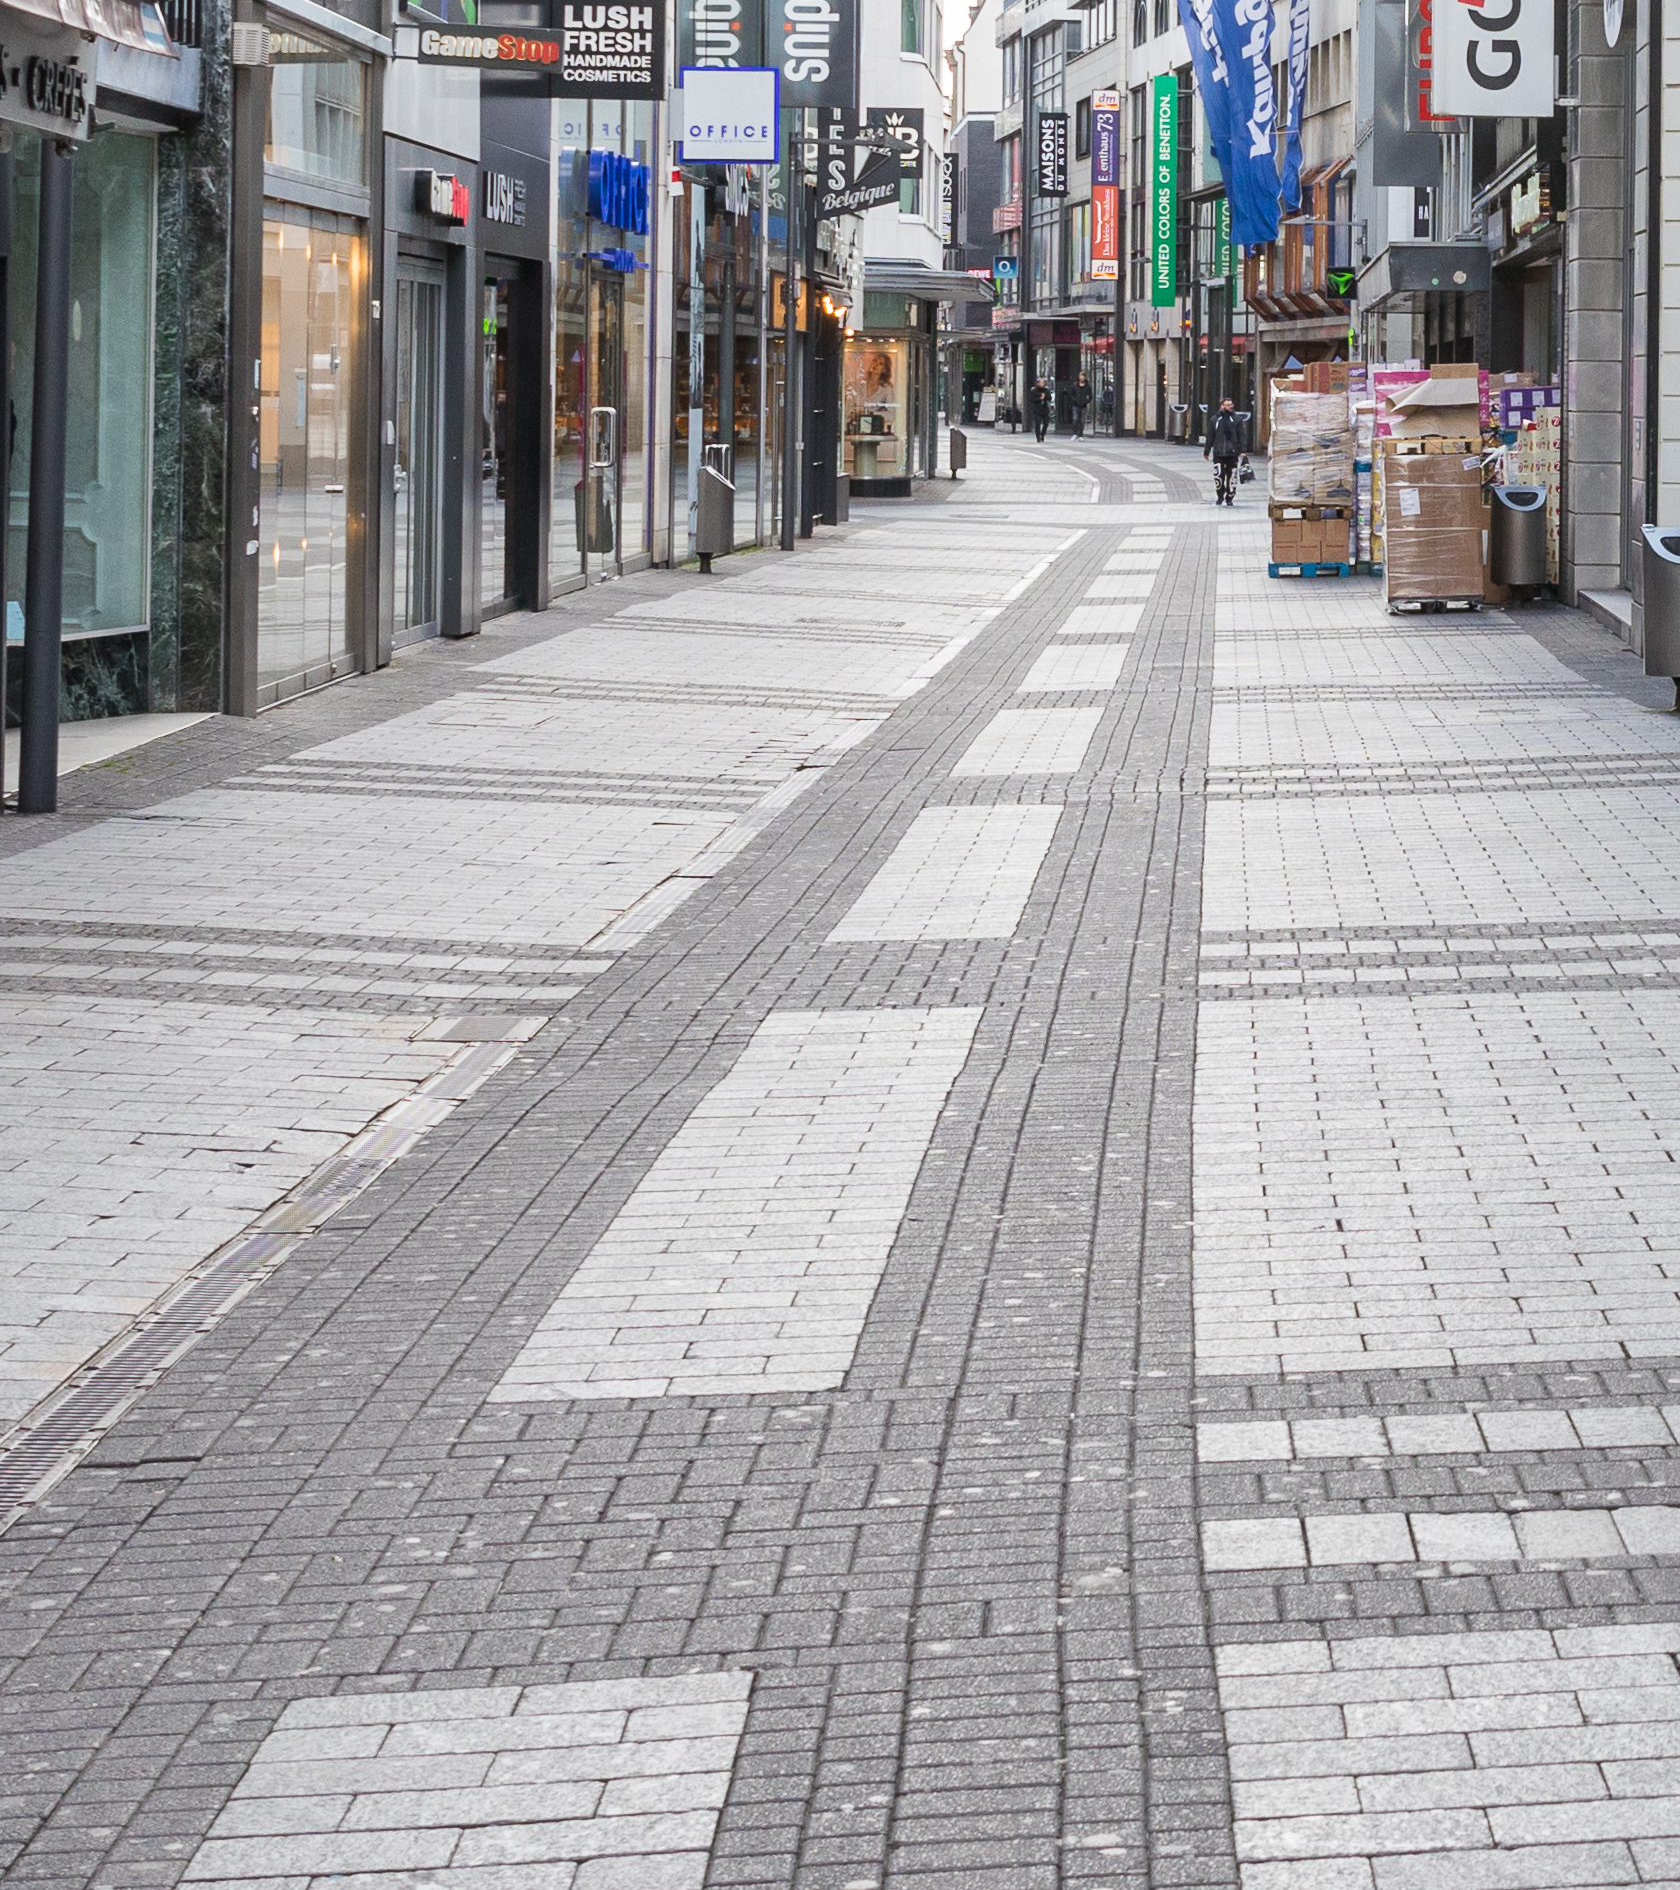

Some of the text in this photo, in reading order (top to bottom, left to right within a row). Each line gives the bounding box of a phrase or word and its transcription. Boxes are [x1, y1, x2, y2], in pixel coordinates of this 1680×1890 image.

[563, 4, 653, 30] LUSH
[420, 29, 560, 64] GameStop
[563, 31, 653, 53] FRESH
[563, 54, 652, 69] HANDMADE
[563, 69, 652, 84] COSMETICS
[1098, 92, 1117, 104] dm
[689, 124, 769, 139] OFFICE
[1096, 113, 1115, 132] 73
[1041, 118, 1055, 192] MAISONS
[1057, 119, 1066, 192] DU MONDE
[1158, 165, 1171, 184] OF
[485, 170, 515, 225] LUSH
[822, 182, 895, 211] Belgique
[1158, 189, 1170, 240] COLORS
[1096, 262, 1116, 273] dm
[1159, 243, 1170, 289] UNITED
